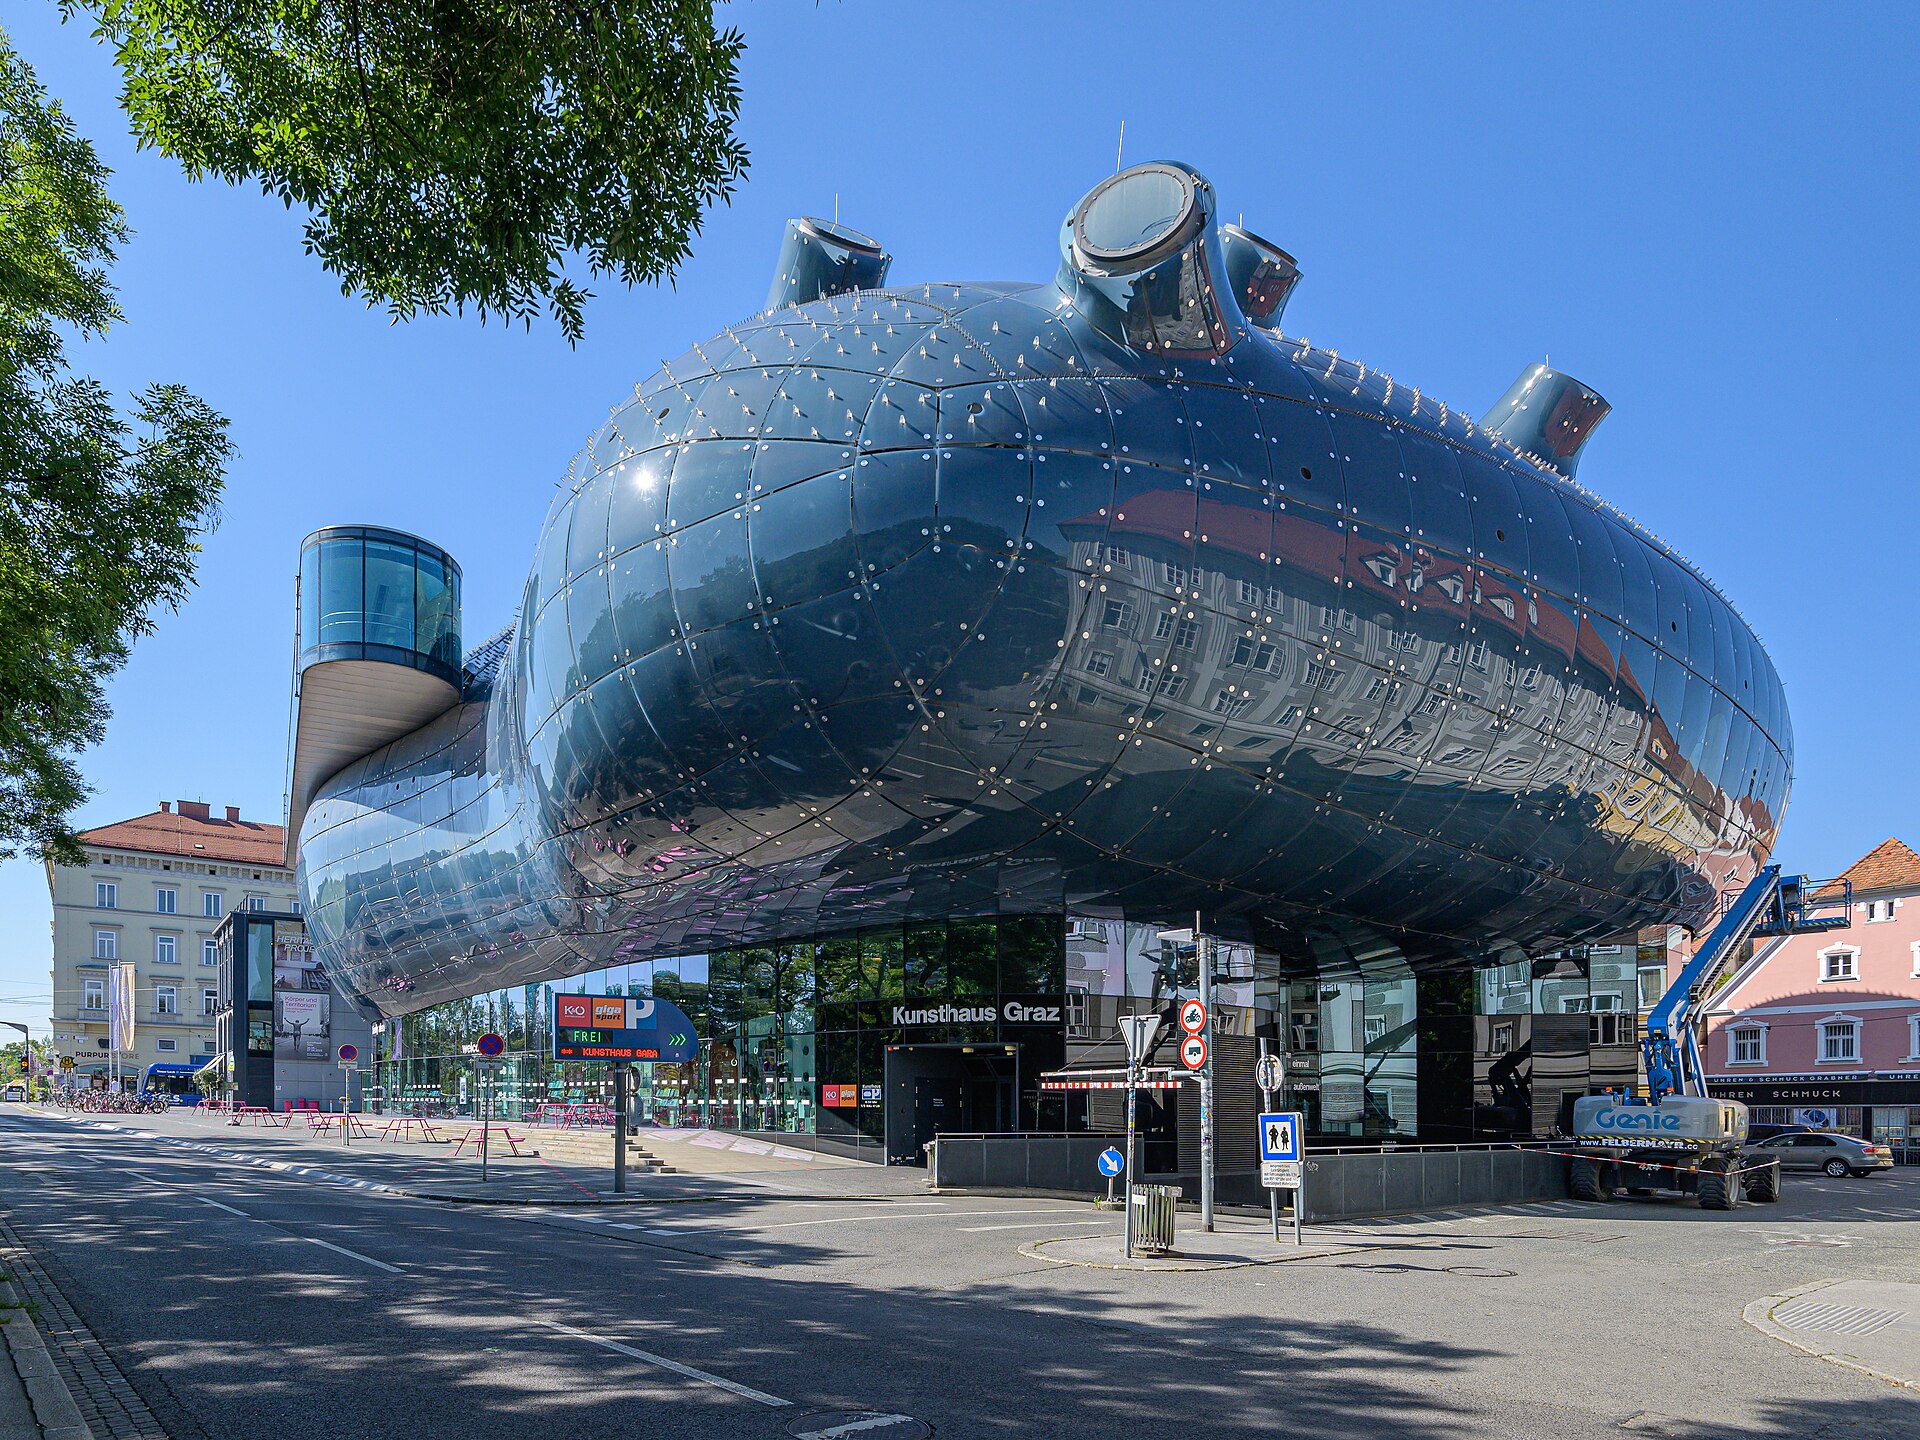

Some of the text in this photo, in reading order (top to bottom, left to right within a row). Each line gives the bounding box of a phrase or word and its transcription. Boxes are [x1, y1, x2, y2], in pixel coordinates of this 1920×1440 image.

[595, 1004, 622, 1015] giga
[626, 999, 655, 1029] P
[892, 1001, 1061, 1025] Kunsthaus Graz
[573, 1030, 601, 1042] FREI
[75, 1051, 140, 1060] PURPUR SORE
[582, 1048, 658, 1058] KUNSTHAUS GARA
[1292, 1059, 1310, 1068] einmal
[1772, 1090, 1841, 1098] SCHMUCK
[1595, 1107, 1681, 1131] Genie
